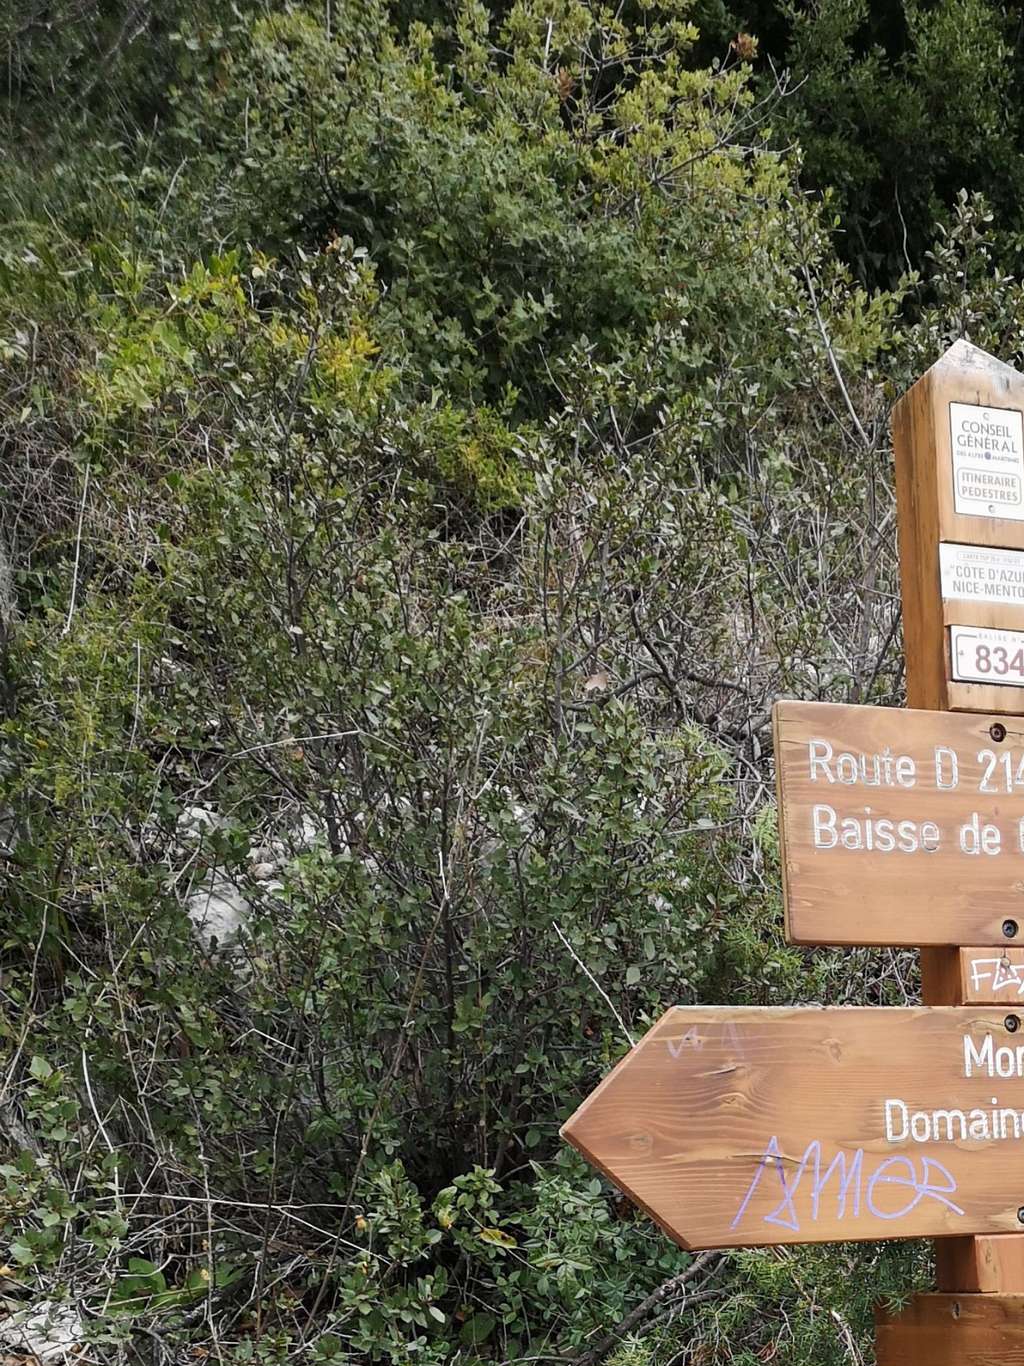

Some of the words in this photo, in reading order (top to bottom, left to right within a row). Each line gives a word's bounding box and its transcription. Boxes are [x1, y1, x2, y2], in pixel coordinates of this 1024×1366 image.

[957, 433, 1018, 453] GÉNÉRAL
[961, 420, 1012, 438] CONSEIL
[808, 739, 917, 787] Route
[933, 746, 960, 790] D
[812, 804, 941, 854] Baisse
[960, 812, 1002, 857] de
